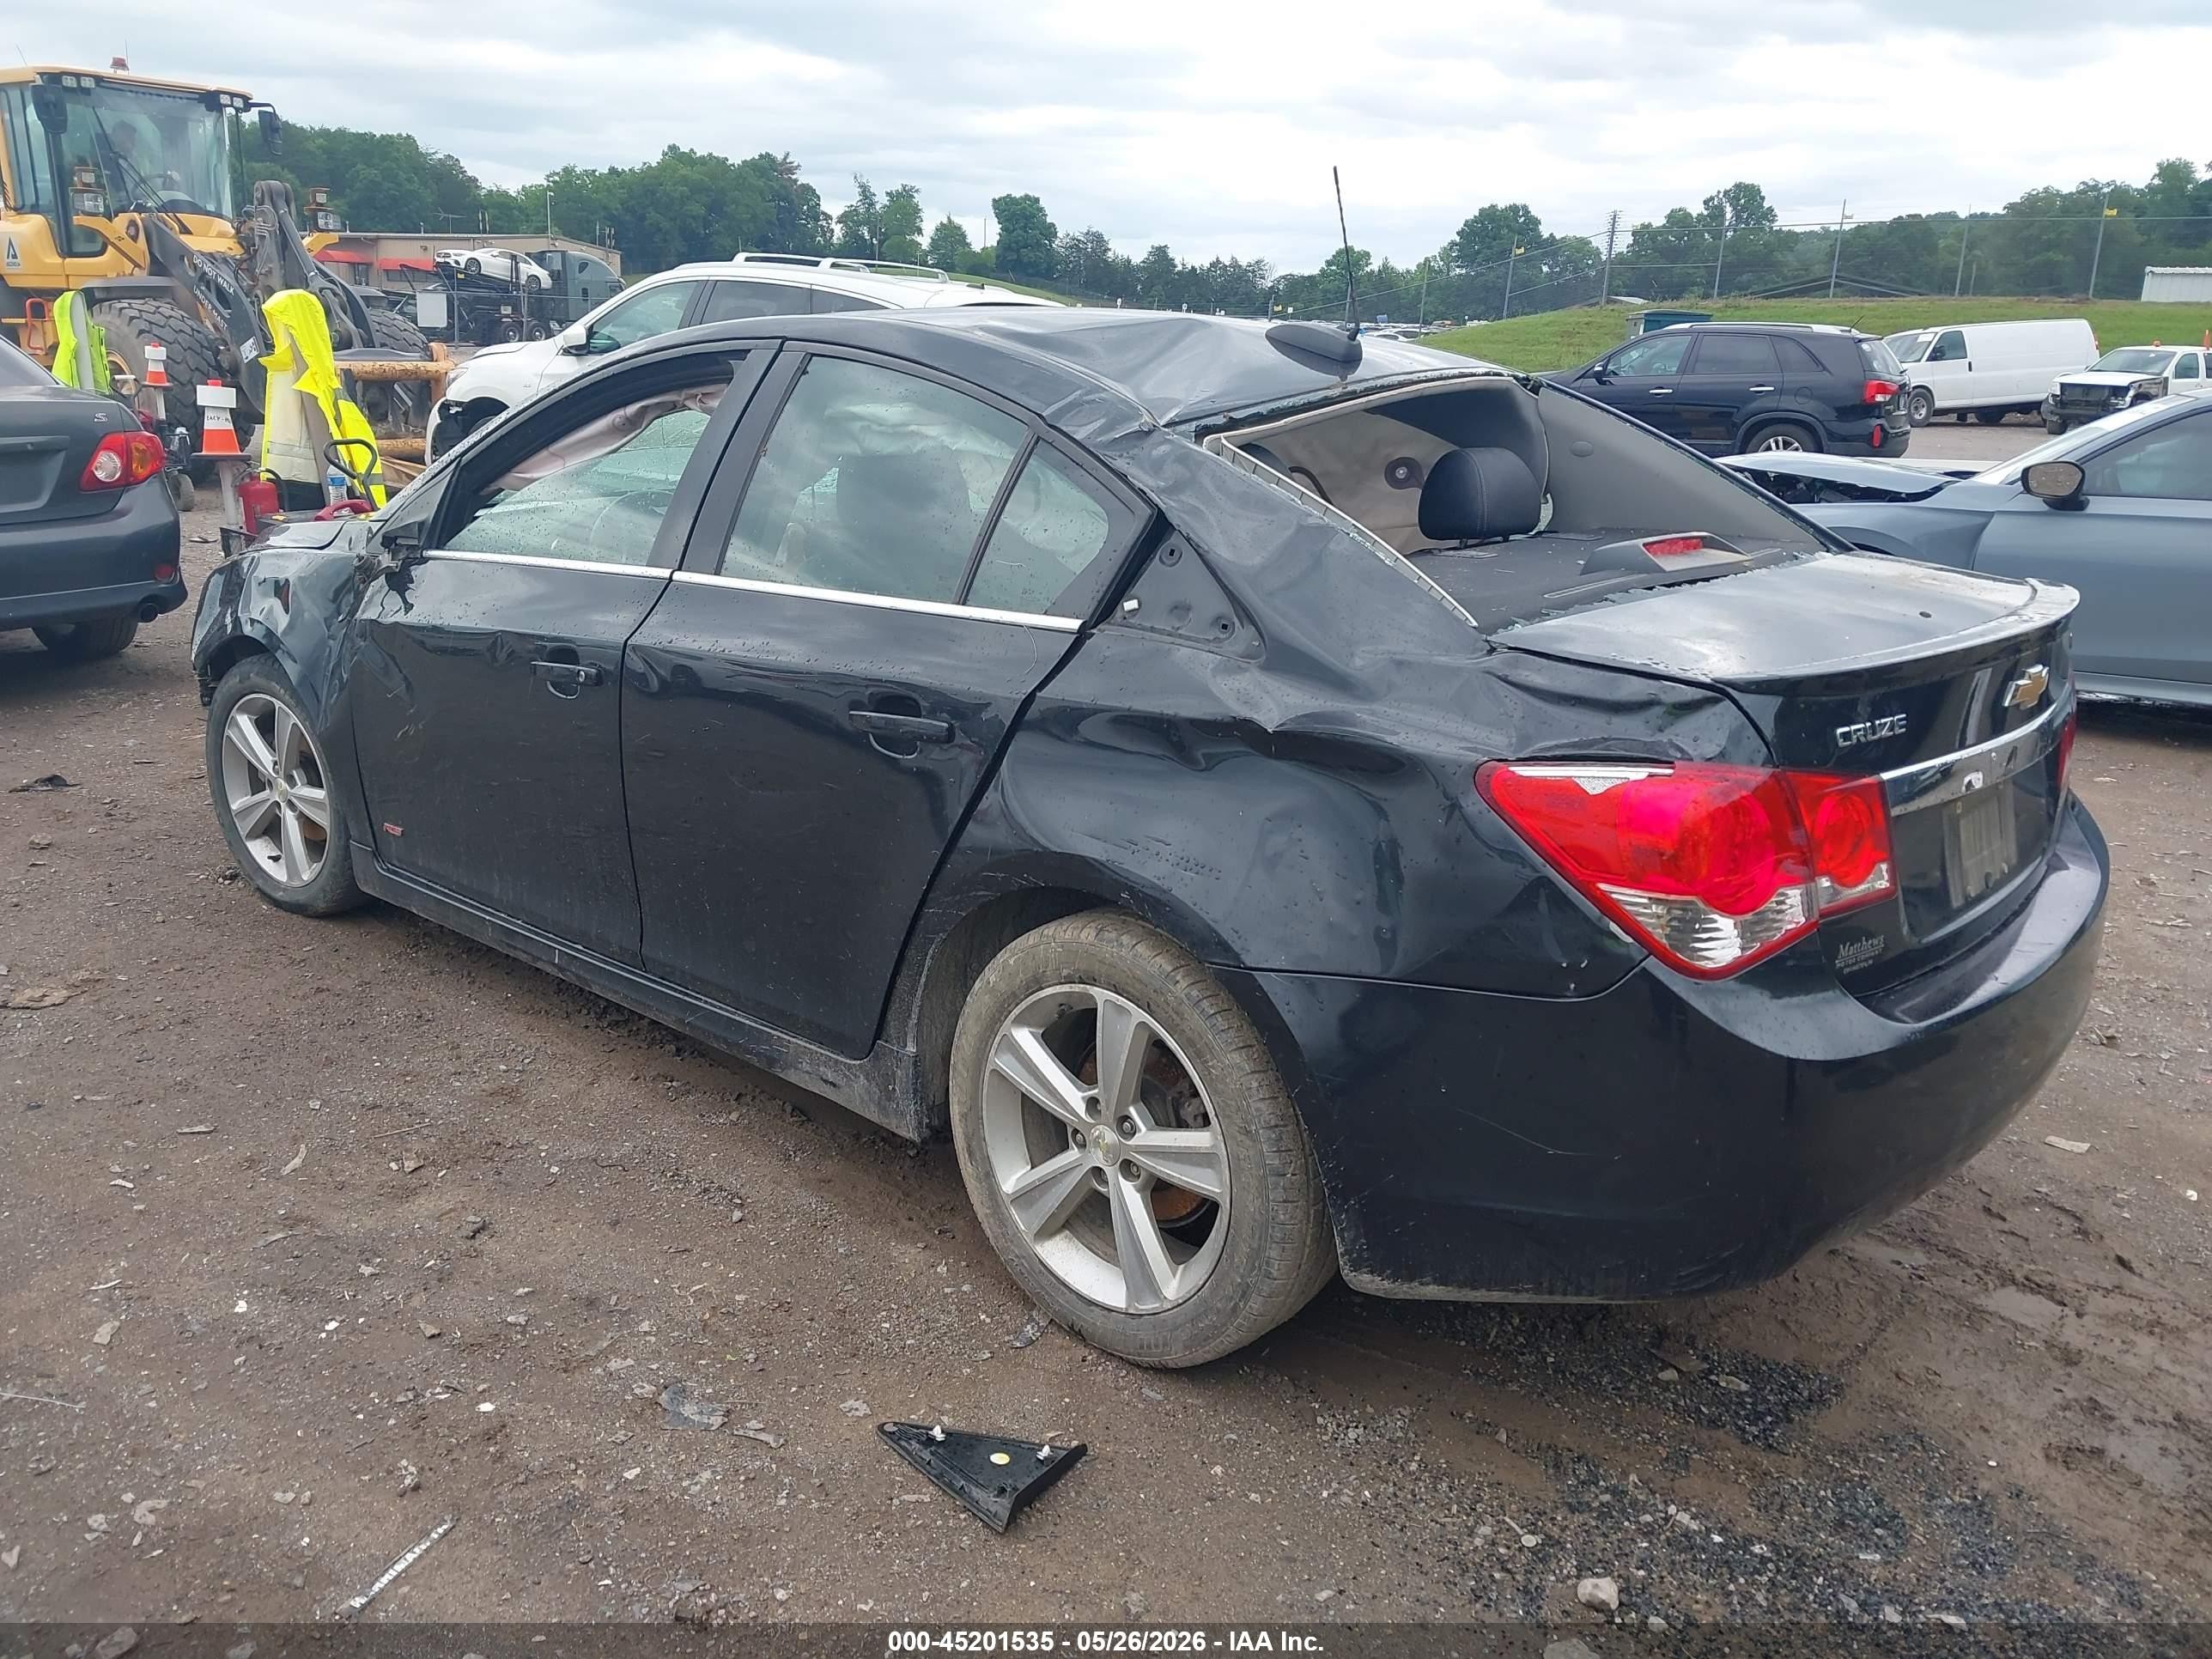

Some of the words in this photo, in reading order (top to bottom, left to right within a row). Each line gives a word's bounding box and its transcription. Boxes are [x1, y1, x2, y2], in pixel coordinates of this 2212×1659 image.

[193, 254, 203, 268] DO
[203, 265, 216, 281] NOT
[217, 276, 234, 296] WALK
[193, 285, 212, 311] UNDER
[213, 309, 228, 331] MAST
[1836, 714, 1907, 748] CRUZE
[1837, 934, 1885, 959] Matthews
